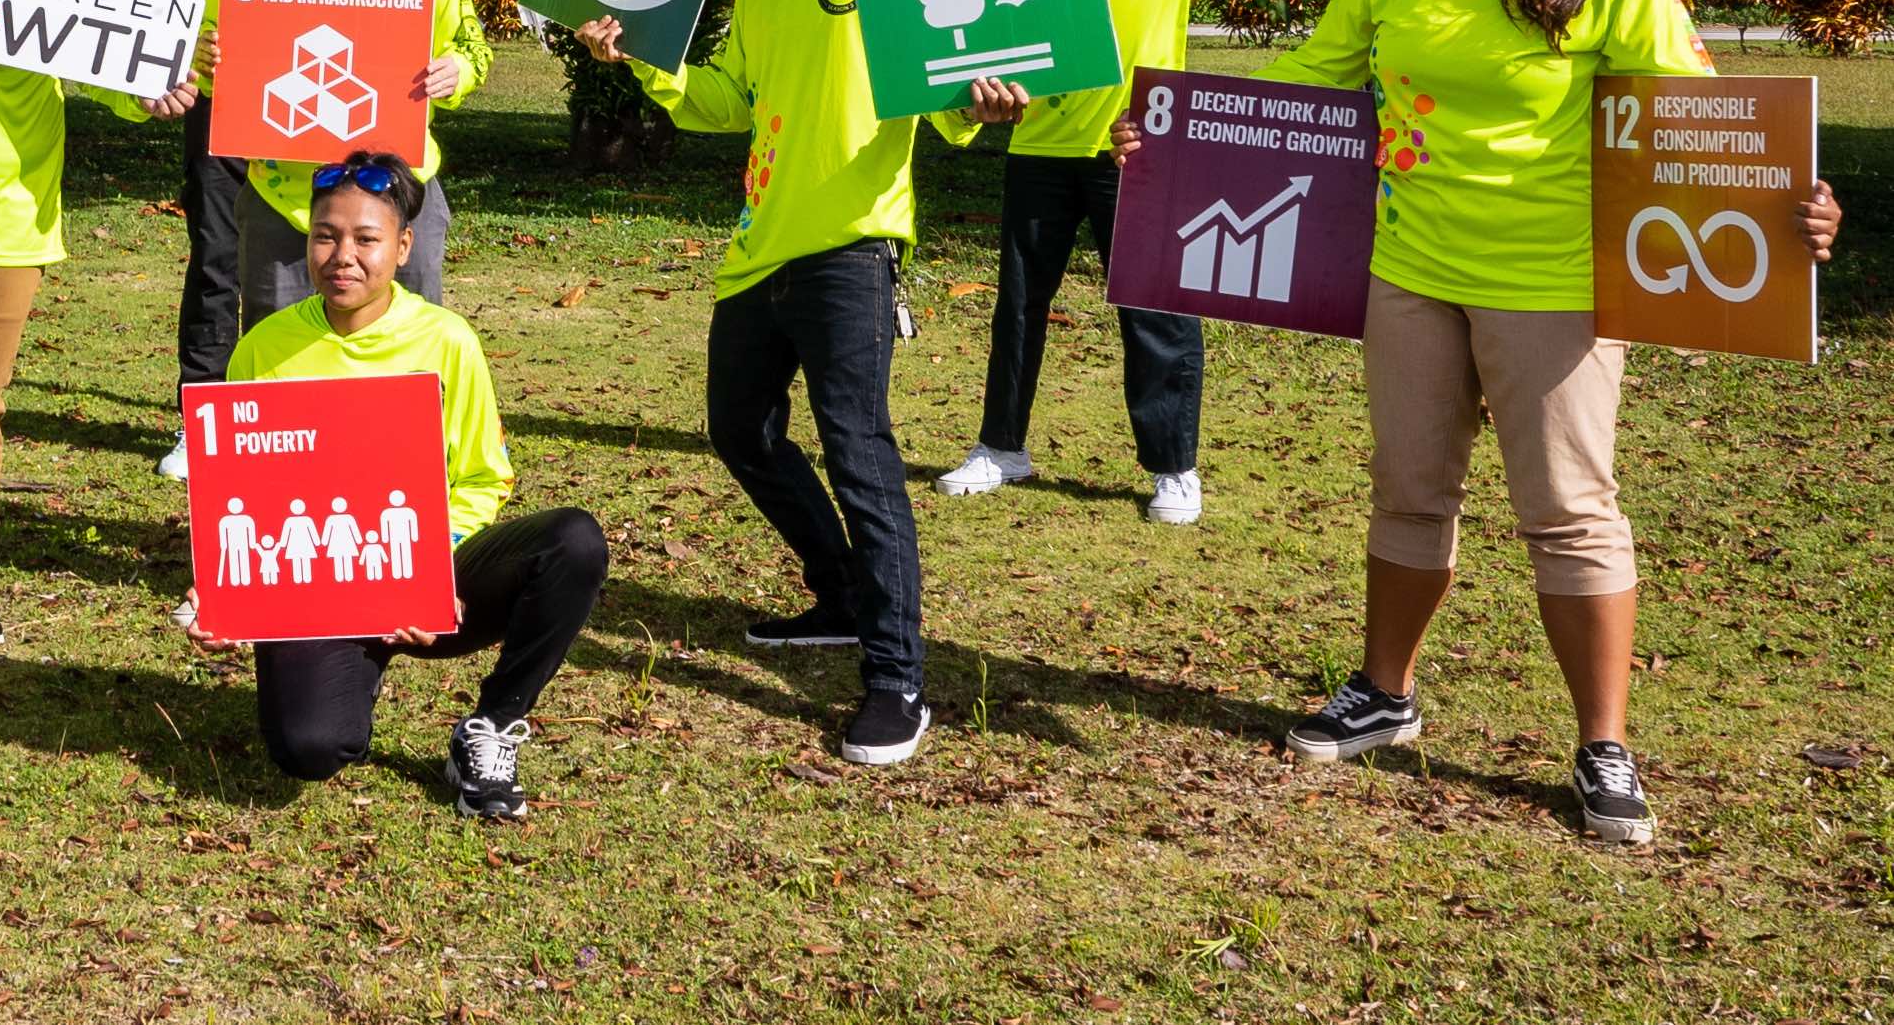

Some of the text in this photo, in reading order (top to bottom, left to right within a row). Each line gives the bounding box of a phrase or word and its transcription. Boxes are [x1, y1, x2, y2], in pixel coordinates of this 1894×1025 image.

[1145, 86, 1173, 135] 8
[1191, 91, 1356, 127] DECENT WORK AND
[1601, 96, 1640, 149] 12
[1655, 96, 1756, 119] RESPONSIBLE
[1188, 120, 1365, 159] ECONOMIC GROWTH
[1654, 129, 1765, 154] CONSUMPTION
[1654, 162, 1790, 189] AND PRODUCTION
[233, 401, 258, 423] NO
[196, 403, 217, 455] 1
[235, 430, 316, 454] POVERTY
